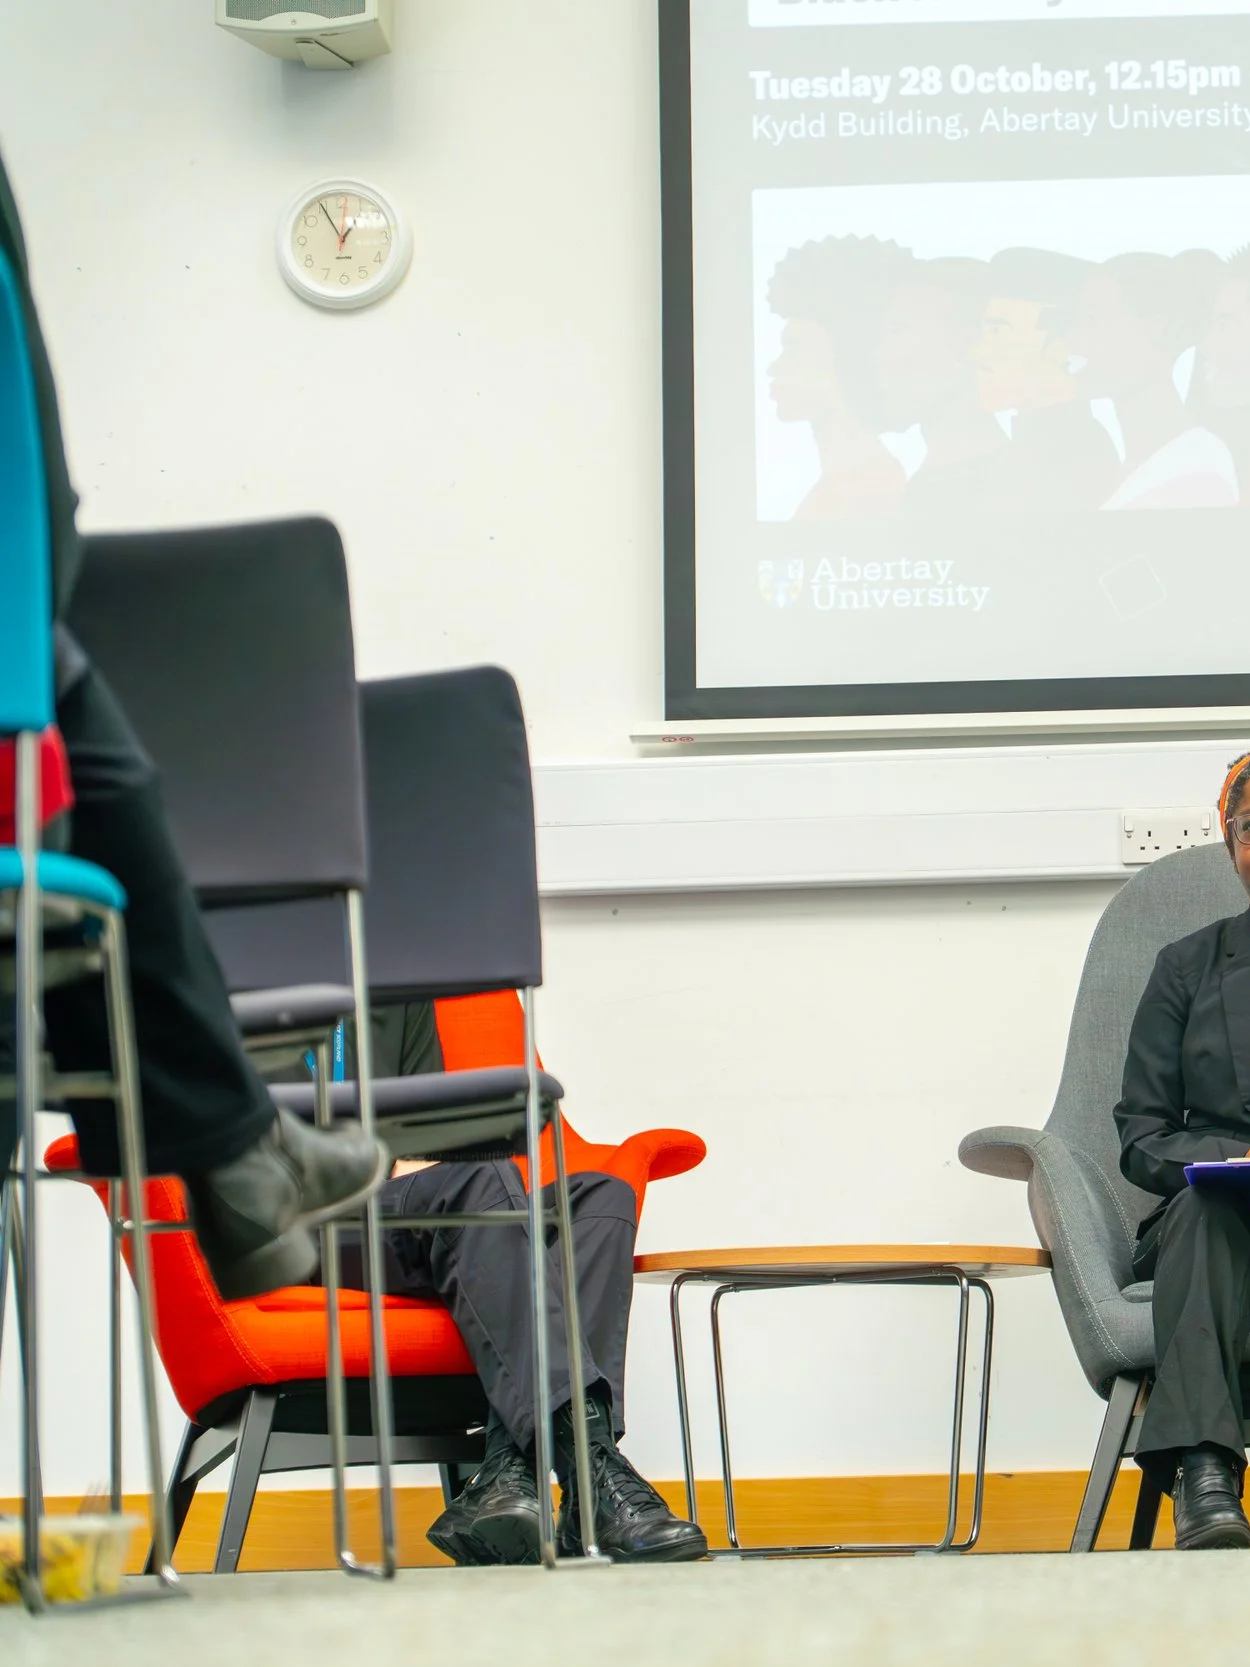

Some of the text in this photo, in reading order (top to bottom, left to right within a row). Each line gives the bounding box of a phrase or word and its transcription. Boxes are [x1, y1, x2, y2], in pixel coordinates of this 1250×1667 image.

[749, 68, 891, 103] Tuesday
[899, 65, 943, 96] 28
[949, 62, 1096, 96] October,
[1105, 60, 1241, 95] 12.15pm
[752, 112, 826, 146] Kydd
[838, 109, 970, 140] Building,
[980, 106, 1097, 137] Abertay
[297, 235, 307, 249] 9
[304, 254, 314, 268] 8
[373, 251, 383, 265] 4
[321, 267, 331, 281] 7
[339, 272, 350, 285] 6
[358, 266, 369, 280] 5
[810, 557, 955, 585] Abertay
[810, 580, 990, 611] University
